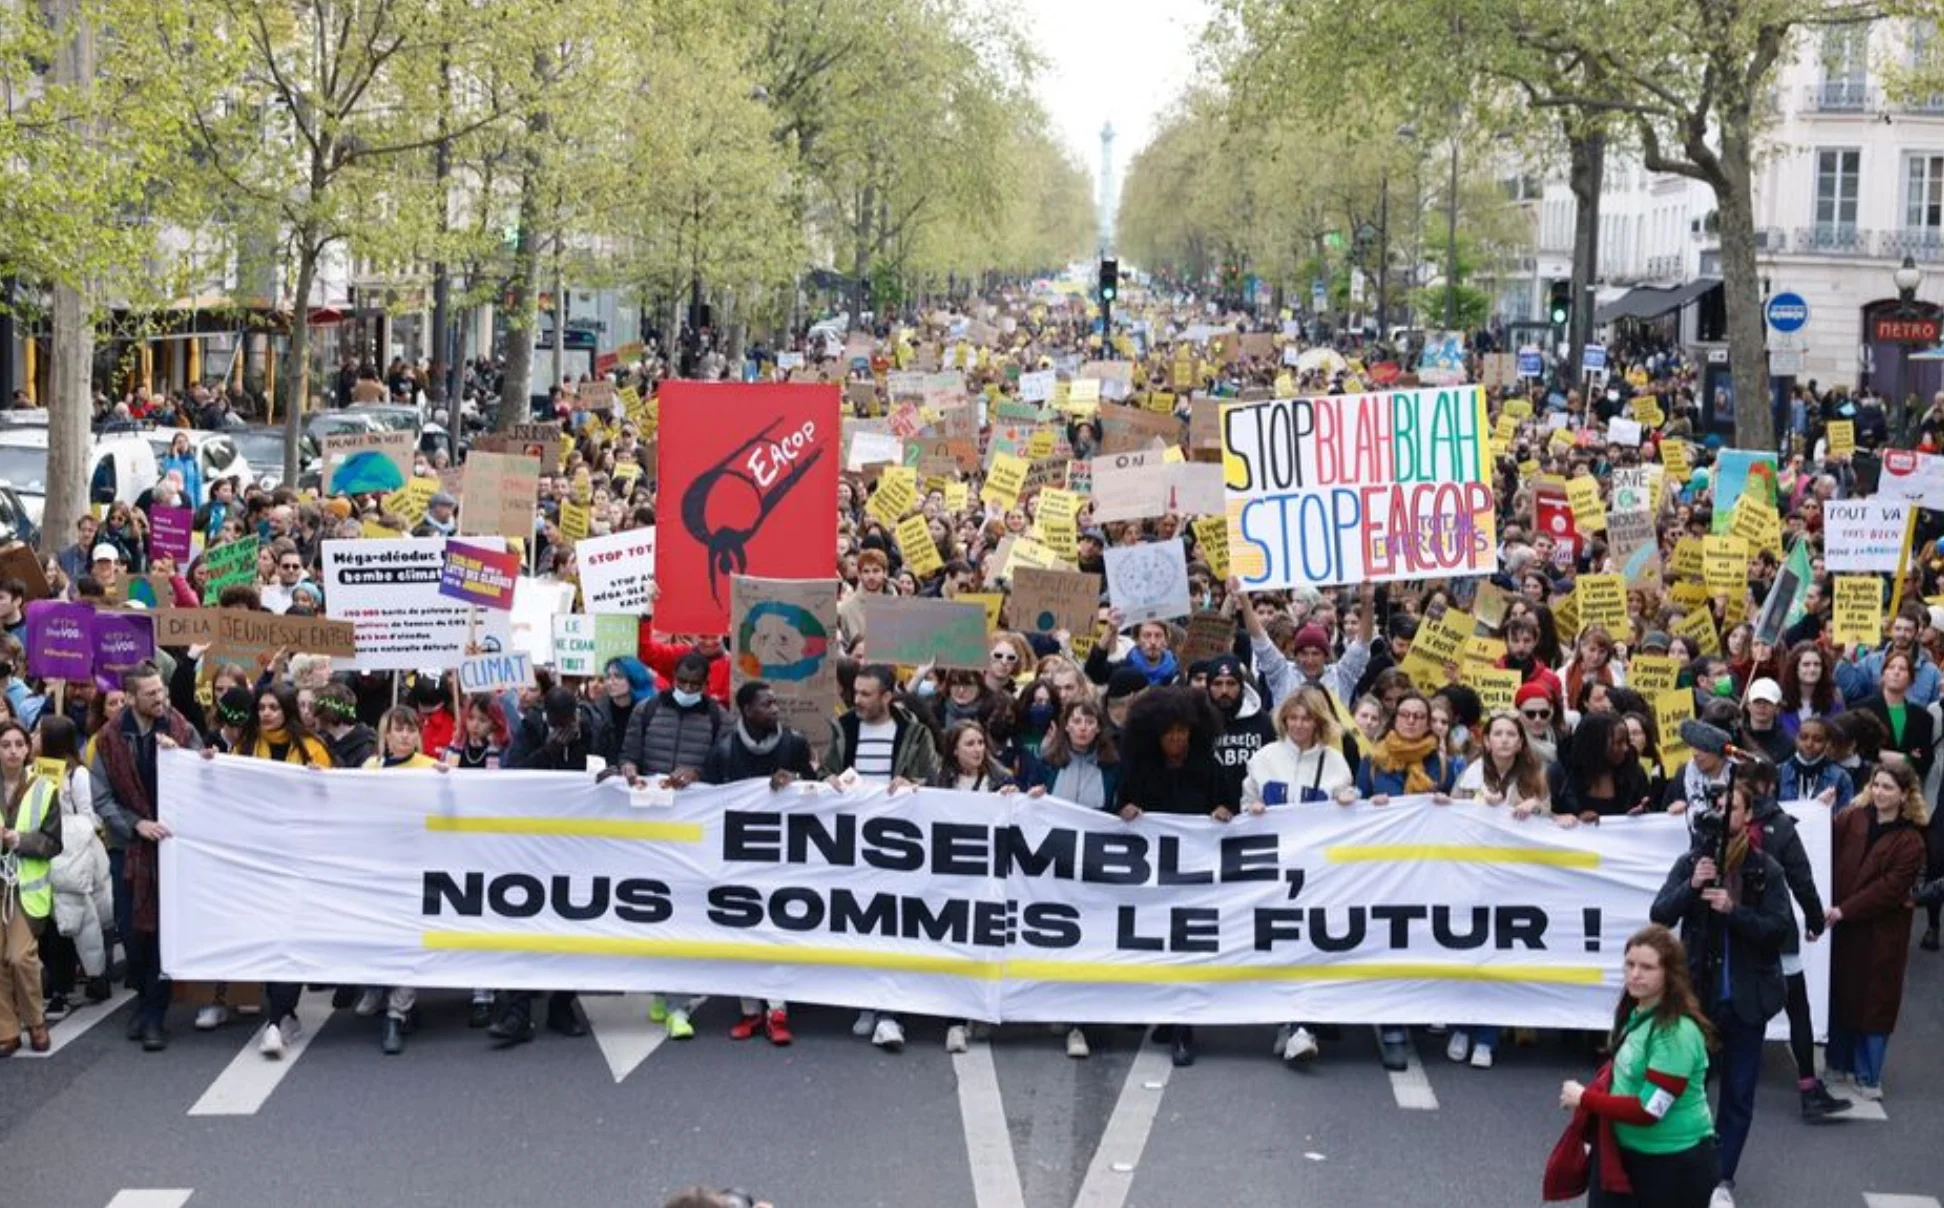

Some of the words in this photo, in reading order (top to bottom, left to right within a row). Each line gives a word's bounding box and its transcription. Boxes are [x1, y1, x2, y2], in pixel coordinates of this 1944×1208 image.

[1877, 321, 1937, 339] METRO
[747, 420, 816, 487] EACOP
[1224, 399, 1315, 493] STOP
[1613, 470, 1649, 488] SAVE
[1828, 506, 1869, 520] TOUT
[1881, 506, 1901, 521] VA
[1240, 488, 1361, 583] STOP
[1360, 482, 1495, 577] EACOP
[333, 549, 436, 567] Méga-oléoduc
[588, 551, 623, 565] STOP
[344, 570, 393, 583] bombe
[610, 575, 637, 588] STOP
[220, 615, 308, 648] JEUNESSE
[460, 654, 526, 689] CLIMAT
[561, 657, 585, 671] TOUT
[723, 809, 1306, 901] ENSEMBLE,
[422, 870, 674, 925] NOUS
[706, 884, 1082, 949] SOMMES
[1115, 904, 1220, 953] LE
[1253, 904, 1549, 953] FUTUR
[1583, 906, 1603, 952] !
